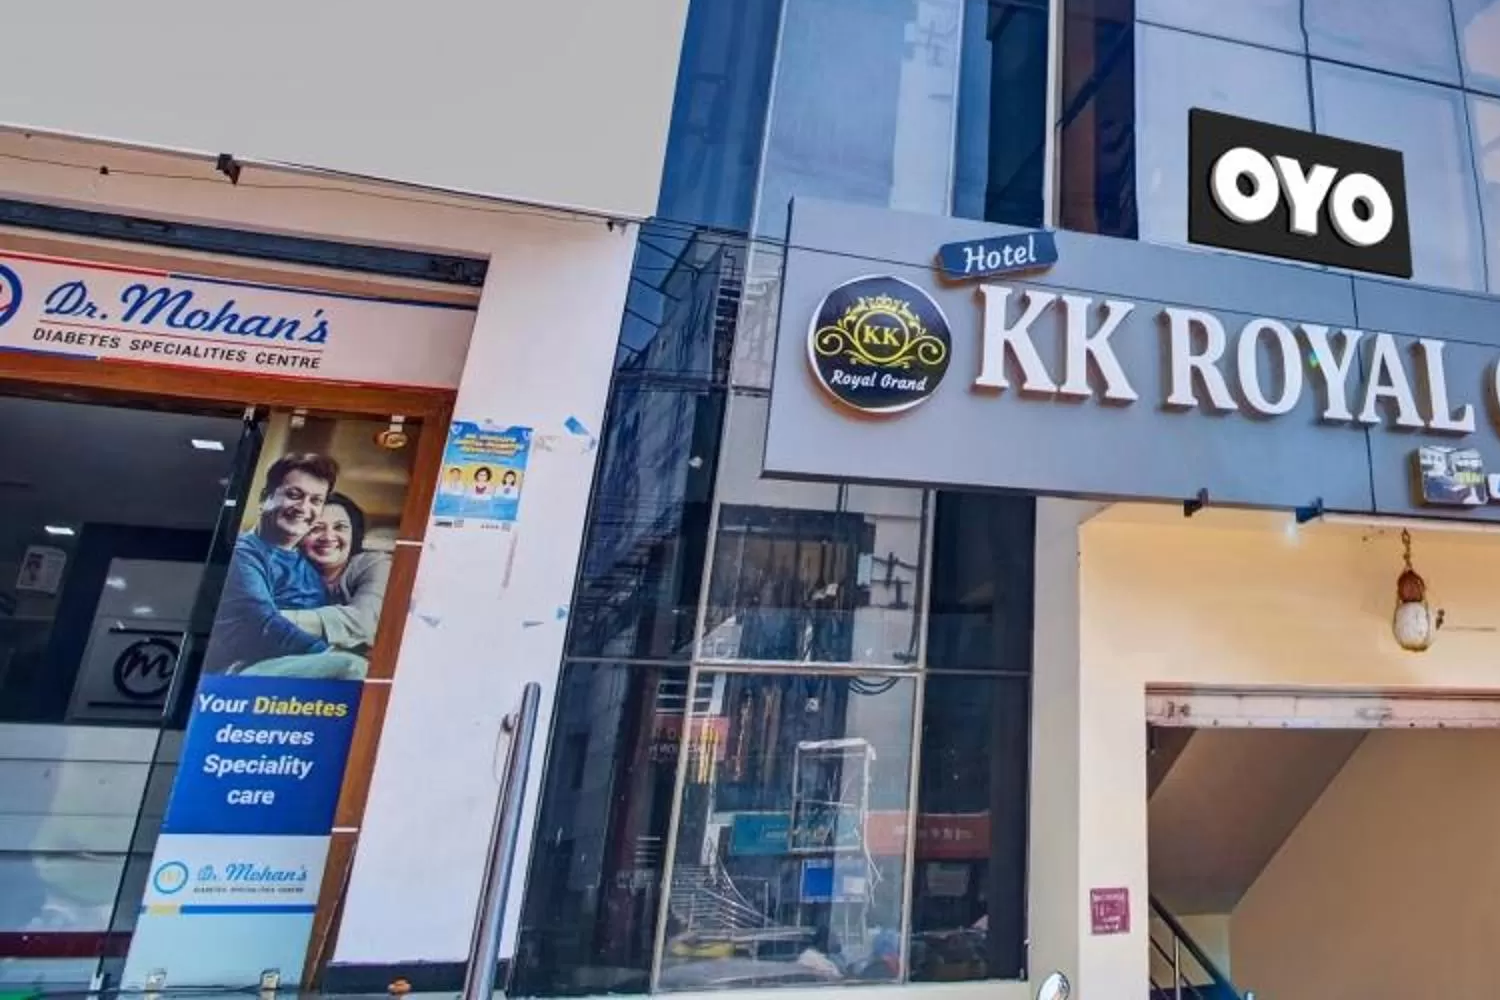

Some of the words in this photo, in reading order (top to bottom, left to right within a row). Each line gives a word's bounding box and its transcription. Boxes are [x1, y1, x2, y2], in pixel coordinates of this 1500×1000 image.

[1211, 146, 1394, 247] OYO
[964, 235, 1036, 273] Hotel
[45, 279, 109, 320] Dr.
[121, 283, 330, 344] Mohan's
[33, 327, 121, 349] DIABETES
[129, 338, 248, 363] SPECIALITIES
[255, 351, 321, 369] CENTRE
[863, 325, 899, 347] KK
[974, 283, 1139, 401] KK
[1165, 307, 1476, 433] ROYAL
[831, 369, 877, 391] Royal
[880, 373, 929, 392] Grand
[199, 692, 248, 714] Your
[253, 695, 349, 718] Diabetes
[215, 723, 315, 746] deserves
[203, 753, 314, 779] Speciality
[227, 789, 275, 806] care
